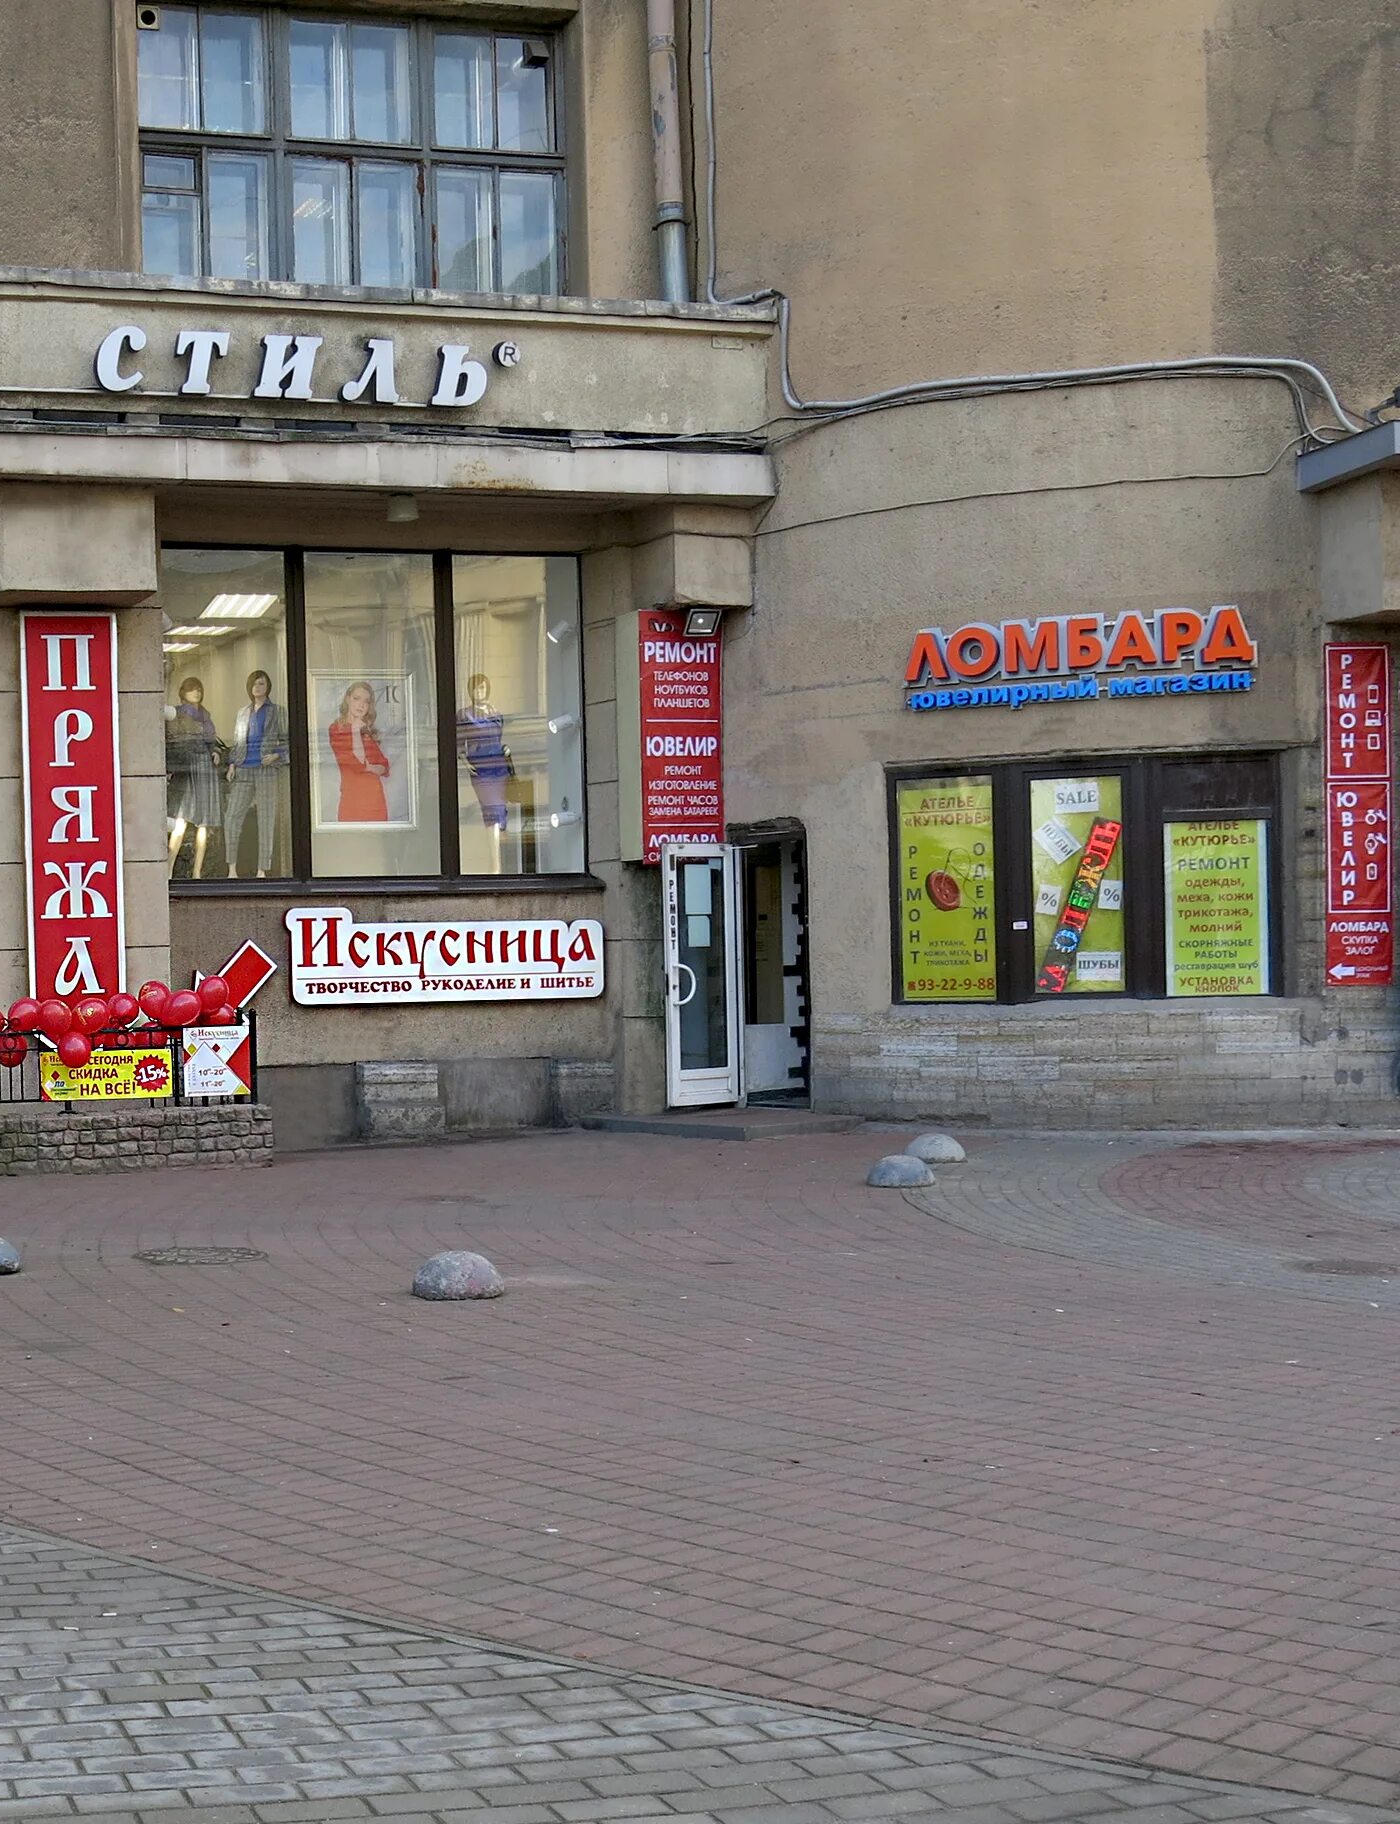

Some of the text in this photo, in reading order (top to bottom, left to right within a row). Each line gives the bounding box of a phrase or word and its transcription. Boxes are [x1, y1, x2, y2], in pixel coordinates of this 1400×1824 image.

[97, 325, 488, 406] стиль
[904, 608, 1255, 682] ЛОМБАРД
[644, 641, 717, 663] РЕМОНТ
[654, 671, 709, 681] ТЕЛЕФОНОВ
[654, 685, 708, 695] НОУТБУКОВ
[910, 672, 1253, 709] ювелирный магазин
[653, 698, 711, 708] ПЛАНШЕТОВ
[1338, 654, 1356, 768] РЕМОНТ
[646, 736, 717, 757] ЮВЕЛИР
[664, 765, 702, 775] РЕМОНТ
[648, 780, 717, 790] ИЗГОТОВЛЕНИЕ
[648, 796, 718, 805] РЕМОНТ ЧАСОВ
[920, 796, 974, 810] АТЕЛЬЕ
[1056, 790, 1097, 805] SALE
[41, 634, 113, 996] ПРЯЖА
[648, 807, 719, 816] ЗАМЕНА БАТАРЕЕК
[904, 812, 991, 827] «КУТЮРЬЕ»
[1173, 834, 1256, 846] «КУТЮРЬЕ»
[1336, 791, 1357, 906] ЮВЕЛИР
[1178, 857, 1250, 871] РЕМОНТ
[1185, 878, 1245, 889] одежды,
[973, 842, 988, 962] ОДЕЖДЫ
[1177, 893, 1254, 903] меха, кожи
[907, 846, 921, 964] РЕМОНТ
[1178, 908, 1253, 919] трикотажа,
[1190, 921, 1243, 932] молний
[1329, 921, 1389, 933] ЛОМБАРД
[1178, 939, 1254, 948] СКОРНЯЖНЫЕ
[1341, 935, 1379, 945] СКУПКА
[297, 917, 596, 979] Искусница
[1344, 946, 1375, 956] ЗАЛОГ
[1194, 950, 1238, 959] РАБОТЫ
[1078, 960, 1119, 970] ШУБЫ
[1239, 960, 1259, 970] шуб
[305, 976, 594, 995] ТВОРЧЕСТВО РУКОДЕЛИЕ И ШИТЬЕ
[918, 978, 995, 991] 93-22-9-88
[1179, 976, 1254, 987] УСТАНОВКА
[1195, 985, 1240, 993] КНОПОК
[88, 1055, 133, 1066] СЕГОДНЯ
[69, 1068, 118, 1080] СКИДКА
[80, 1080, 136, 1096] НА ВСЁ!
